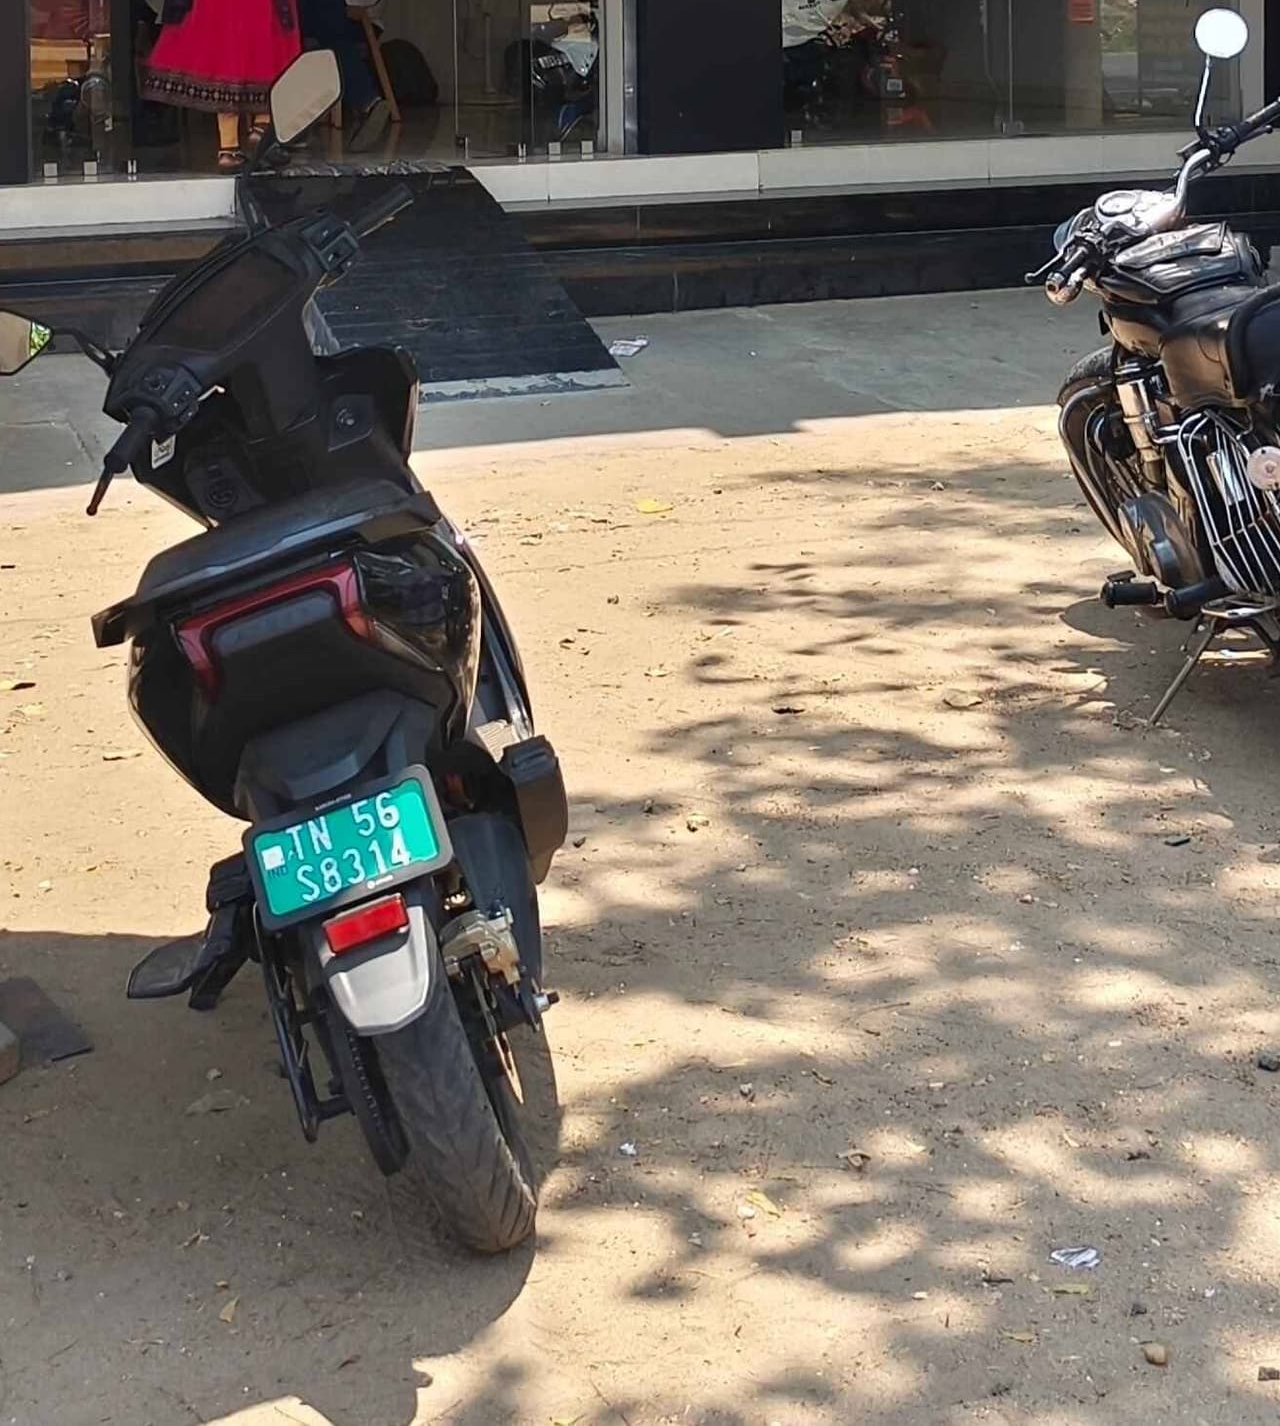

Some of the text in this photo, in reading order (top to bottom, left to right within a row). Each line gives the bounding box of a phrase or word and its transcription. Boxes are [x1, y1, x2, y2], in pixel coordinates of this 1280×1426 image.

[285, 815, 333, 862] TN
[351, 791, 402, 837] 56
[296, 827, 413, 903] S8314
